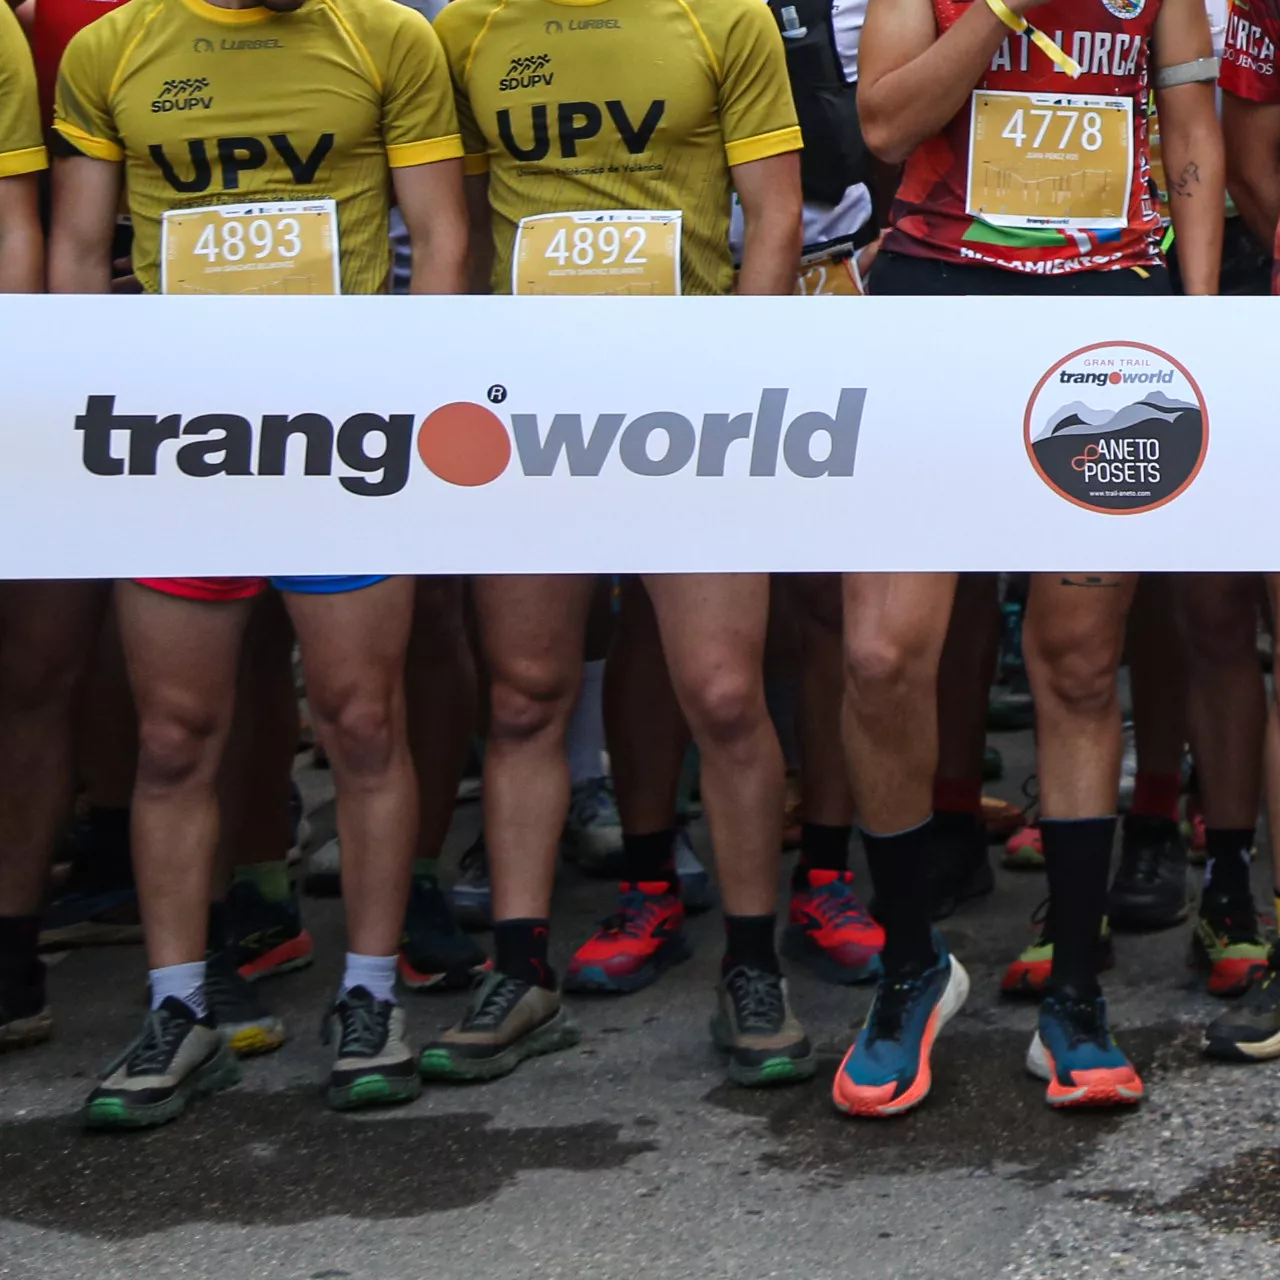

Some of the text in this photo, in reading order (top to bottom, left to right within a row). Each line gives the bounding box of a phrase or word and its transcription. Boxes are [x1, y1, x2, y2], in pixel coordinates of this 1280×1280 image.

[567, 19, 622, 31] LURBEL
[220, 38, 284, 51] LURBEL
[1053, 30, 1142, 77] LORCA
[499, 72, 554, 91] SDUPV
[150, 96, 214, 114] SDUPV
[496, 100, 666, 162] UPV
[1001, 109, 1103, 151] 4778
[148, 133, 335, 194] UPV
[193, 217, 303, 263] 4893
[544, 225, 648, 266] 4892
[1084, 359, 1151, 367] GRAN TRAIL
[1059, 369, 1175, 387] trangoworld
[74, 386, 868, 498] trangoworld
[1098, 438, 1160, 460] ANETO
[1084, 462, 1161, 483] POSETS
